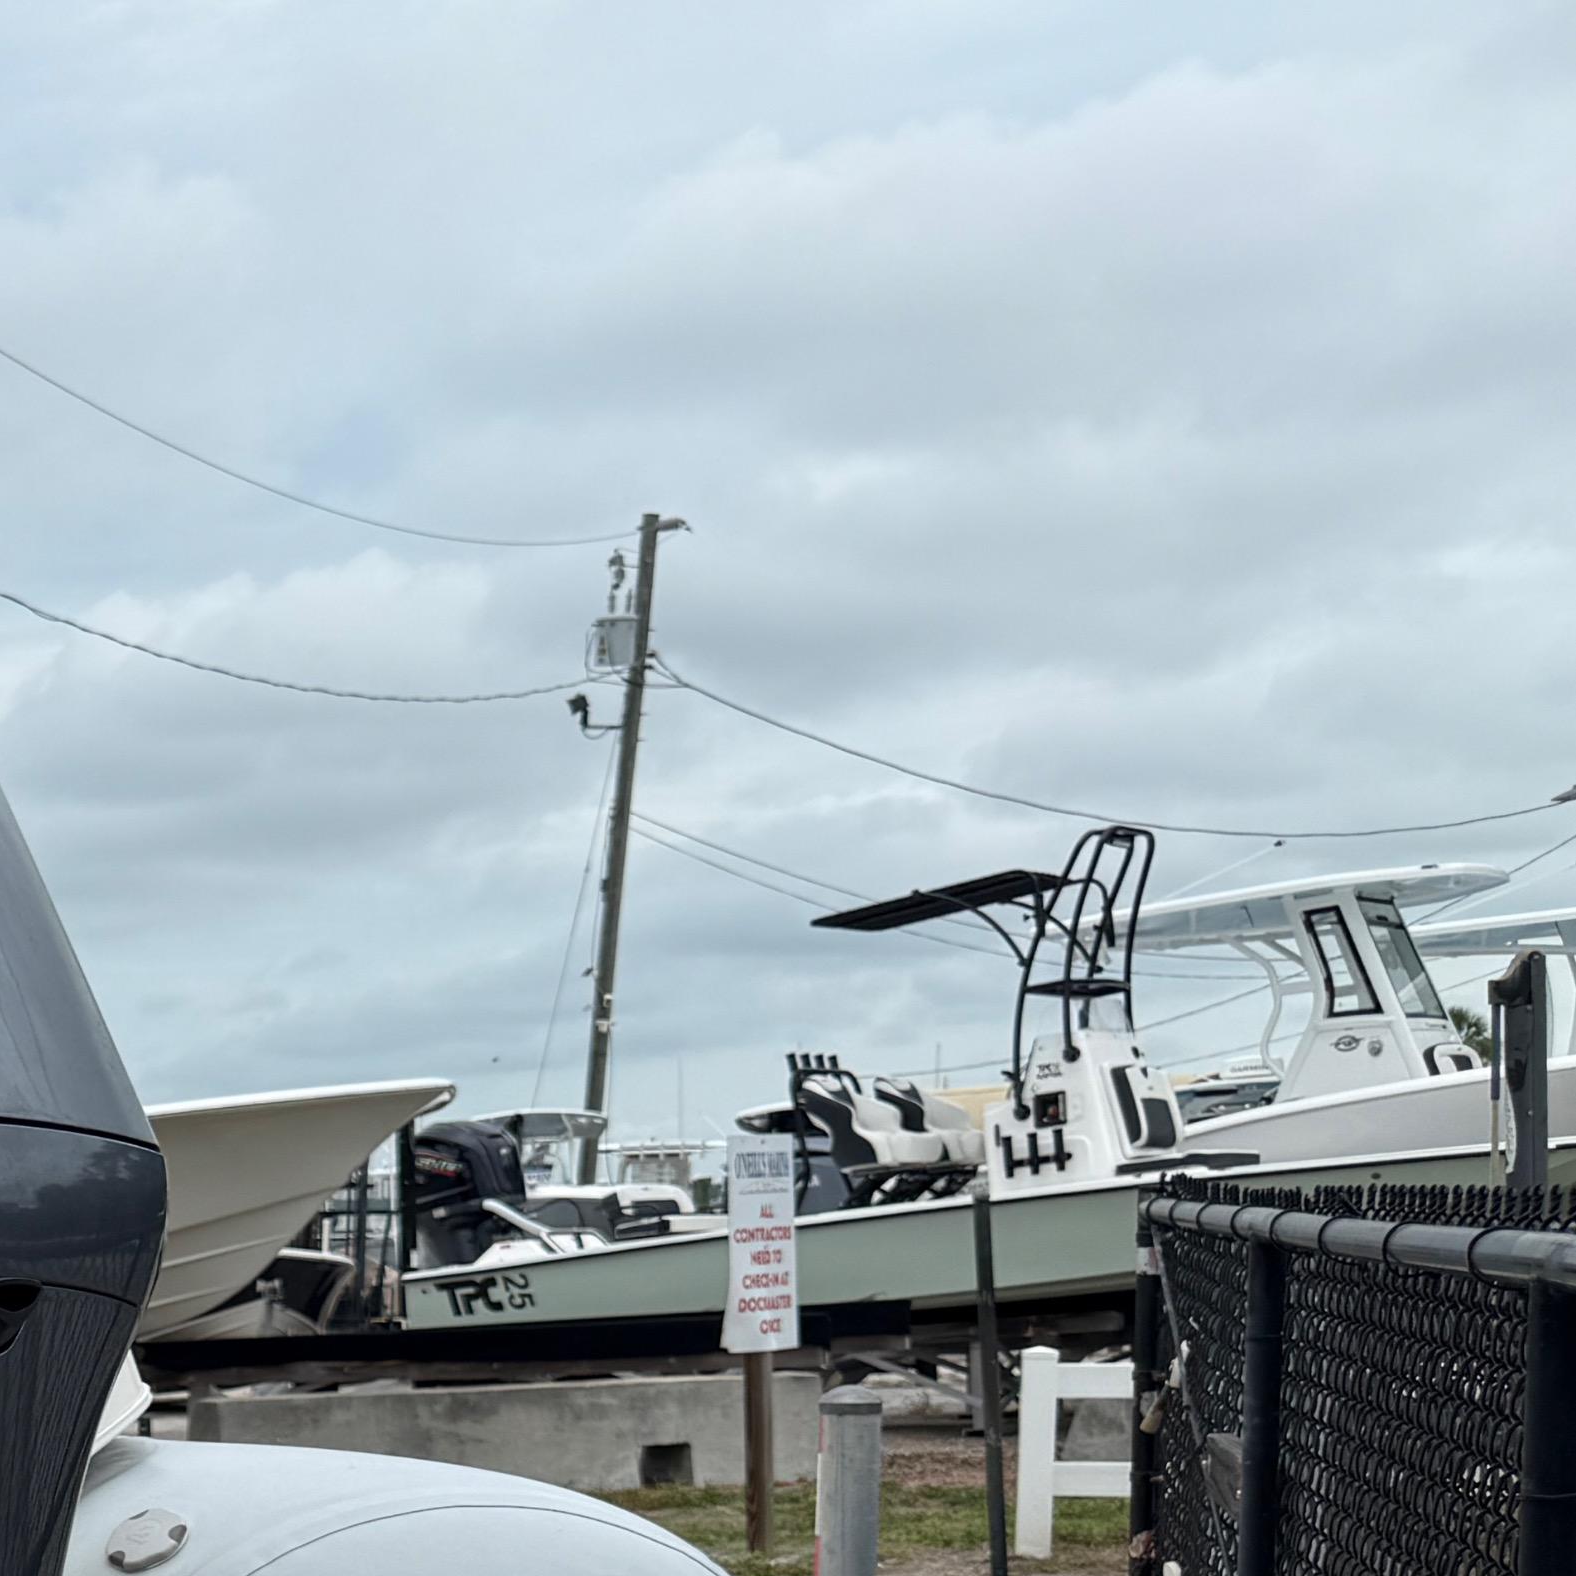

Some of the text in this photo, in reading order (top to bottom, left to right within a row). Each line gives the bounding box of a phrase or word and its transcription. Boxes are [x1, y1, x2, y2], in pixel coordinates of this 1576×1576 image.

[759, 1203, 775, 1219] ALL
[734, 1227, 791, 1243] CONTRACTORS
[433, 1273, 536, 1316] TPC 25
